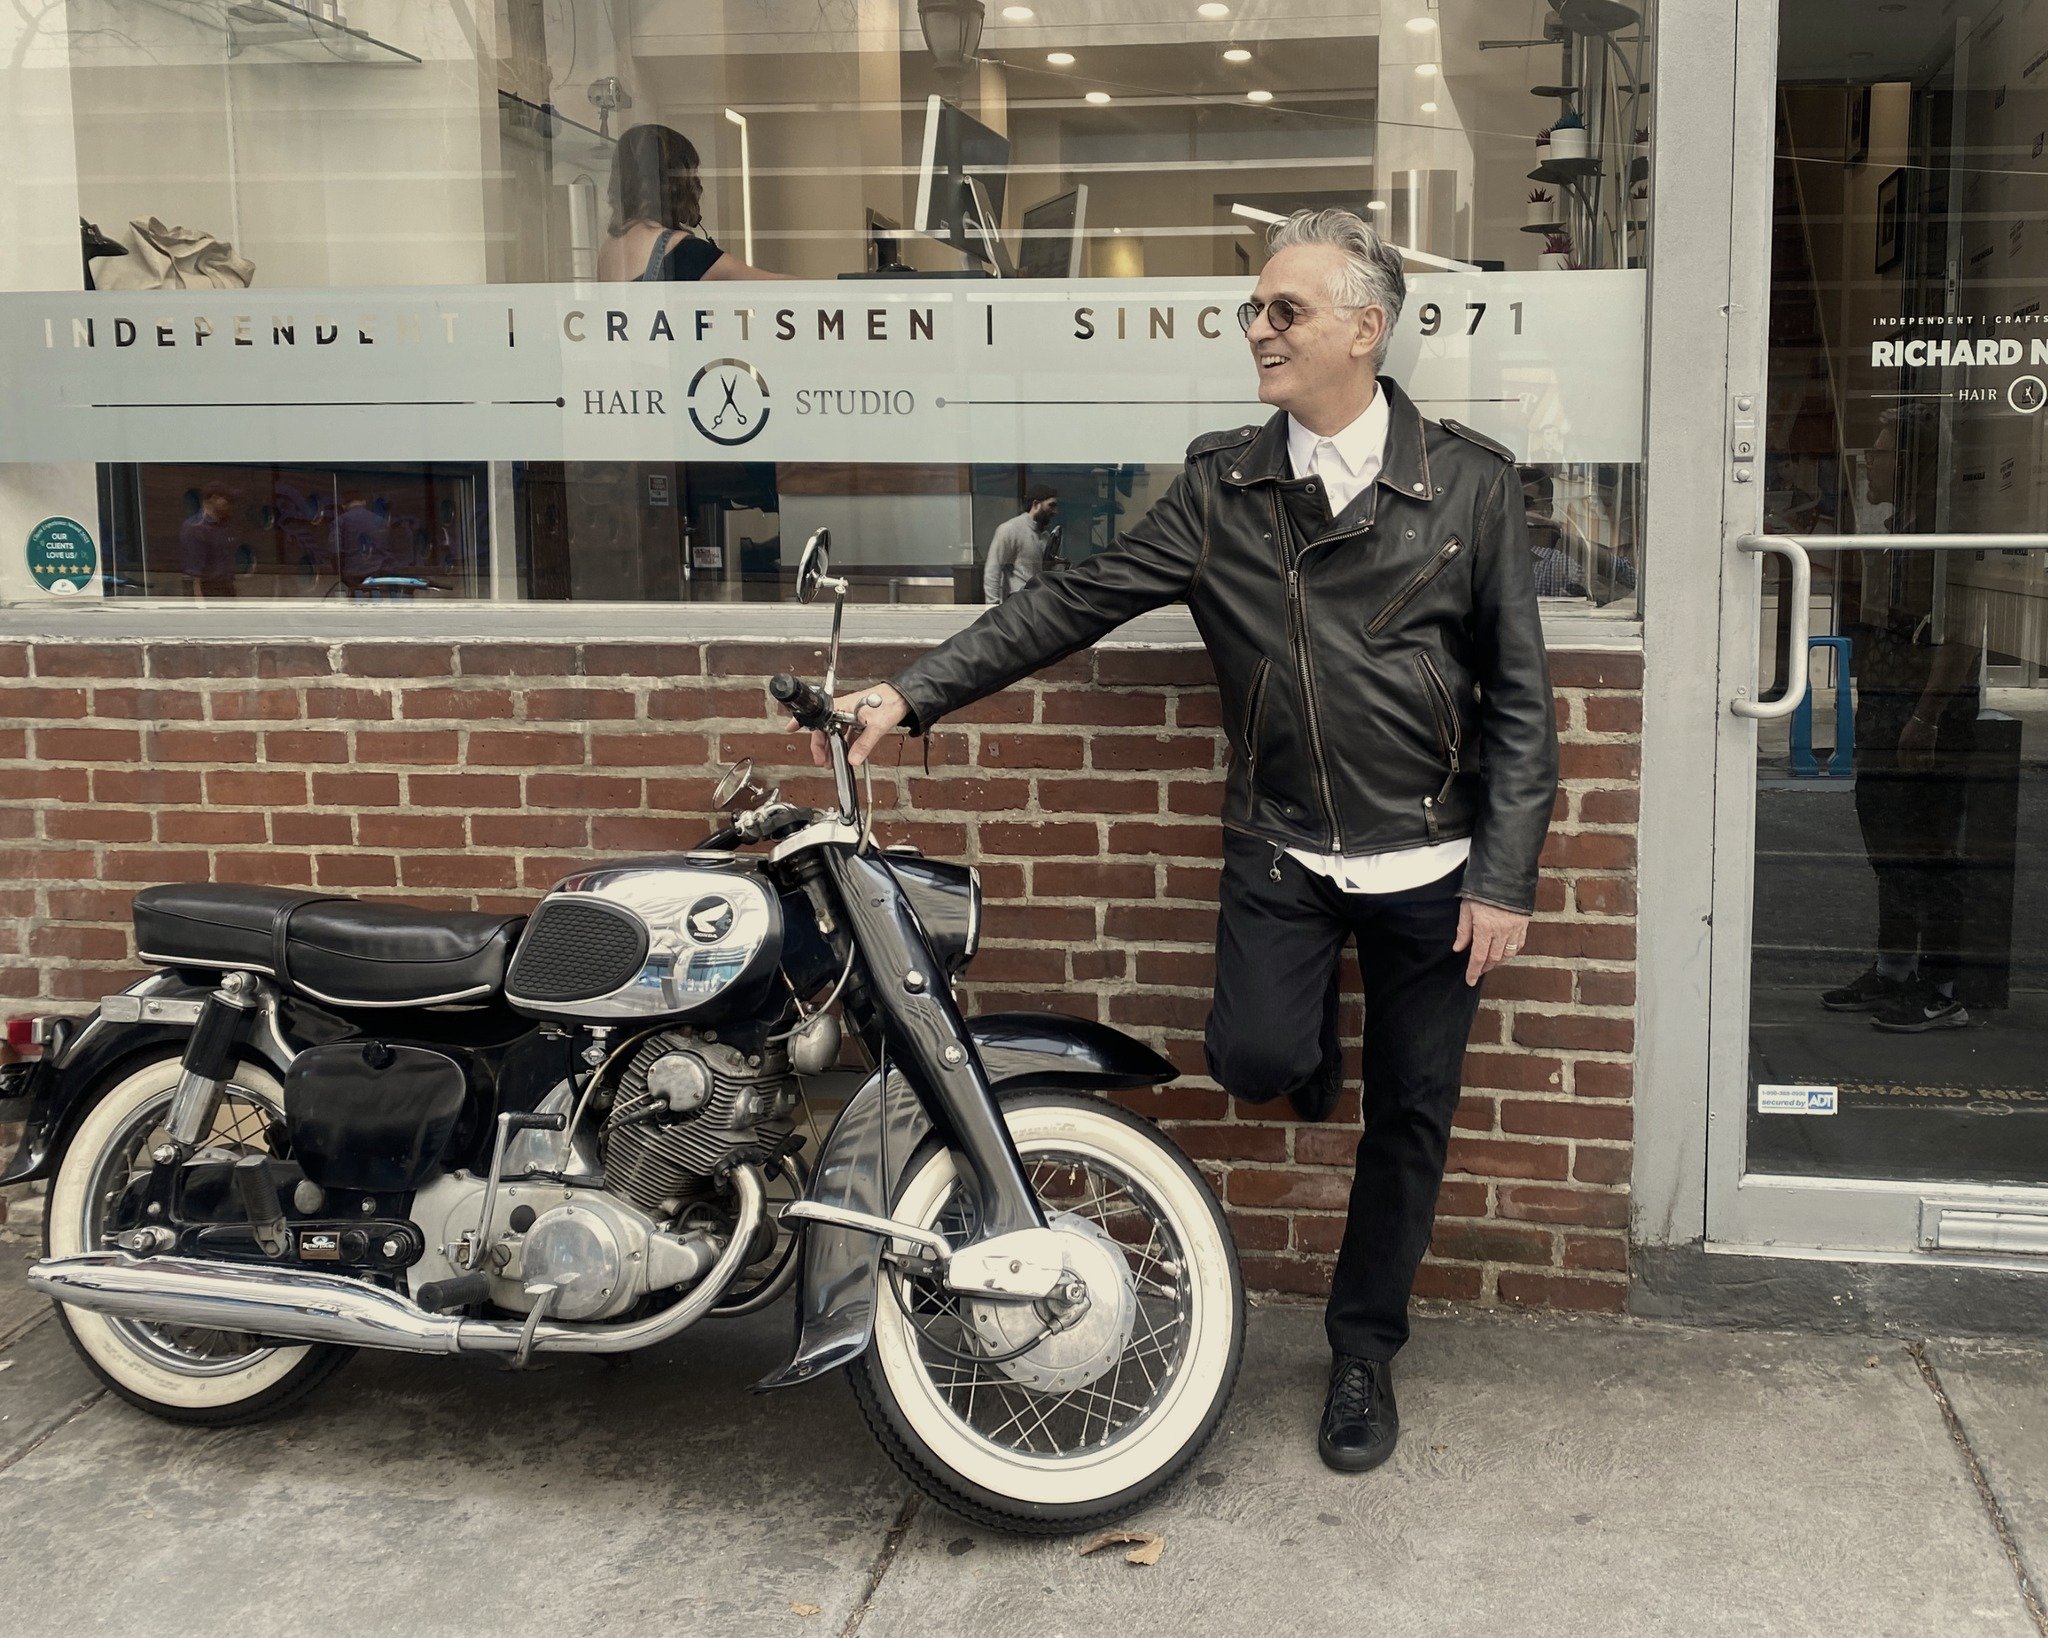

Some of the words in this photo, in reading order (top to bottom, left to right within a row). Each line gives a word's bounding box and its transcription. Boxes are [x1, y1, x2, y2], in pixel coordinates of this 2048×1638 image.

[44, 312, 460, 348] INDEPENDENT
[562, 308, 934, 342] CRAFTSMEN
[1073, 305, 1247, 341] SINC
[1872, 316, 1974, 326] INDEPENDENT
[1871, 339, 2024, 367] RICHARD
[1958, 388, 1997, 401] HAIR
[582, 389, 667, 415] HAIR
[795, 389, 916, 415] STUDIO
[51, 532, 68, 540] OUR
[46, 542, 75, 550] CLIENTS
[46, 551, 65, 559] LOVE
[1795, 1099, 1806, 1107] by
[1808, 1093, 1833, 1108] ADT
